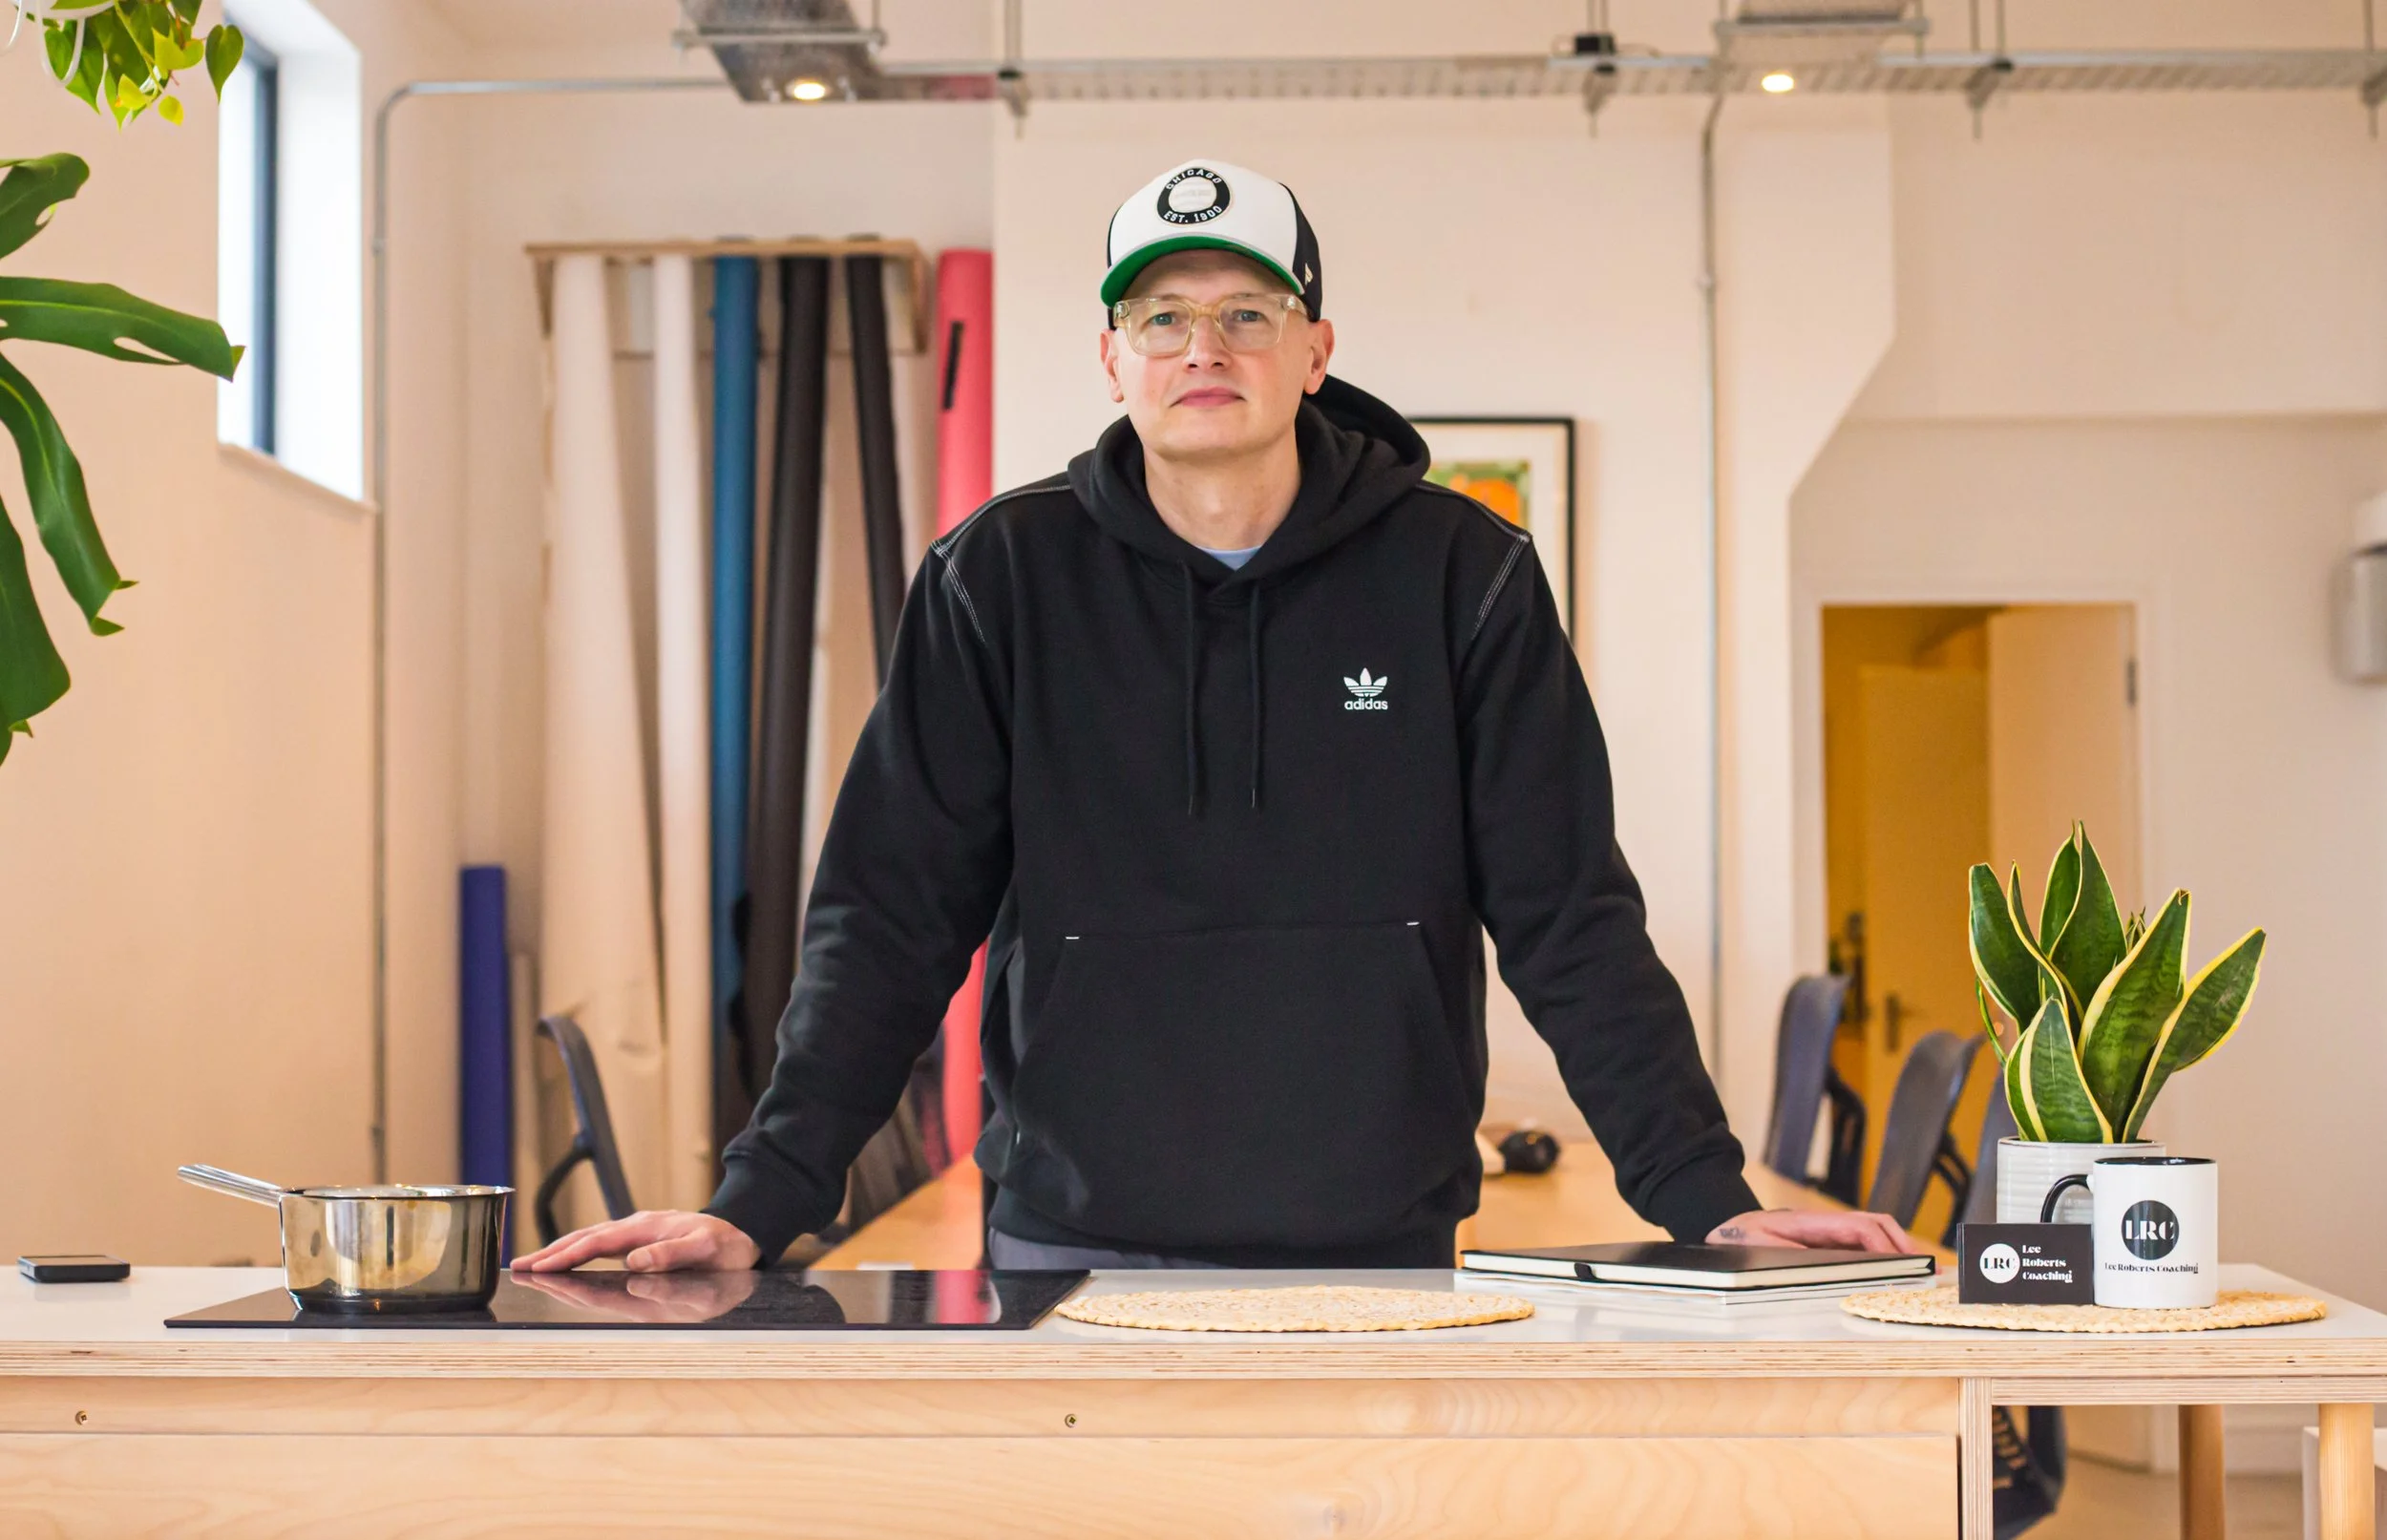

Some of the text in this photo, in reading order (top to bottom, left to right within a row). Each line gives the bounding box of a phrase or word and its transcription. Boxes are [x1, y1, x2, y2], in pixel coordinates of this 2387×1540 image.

[1166, 169, 1222, 190] CHICAGO
[1164, 205, 1222, 222] EST. 1900
[1344, 698, 1388, 710] adidas
[2125, 1220, 2175, 1240] LRC
[2022, 1245, 2041, 1254] Lee
[1984, 1257, 2016, 1270] LRC
[2022, 1258, 2066, 1267] Roberts
[2104, 1262, 2198, 1275] Lee Roberts Coaching
[2022, 1270, 2073, 1283] Coaching
